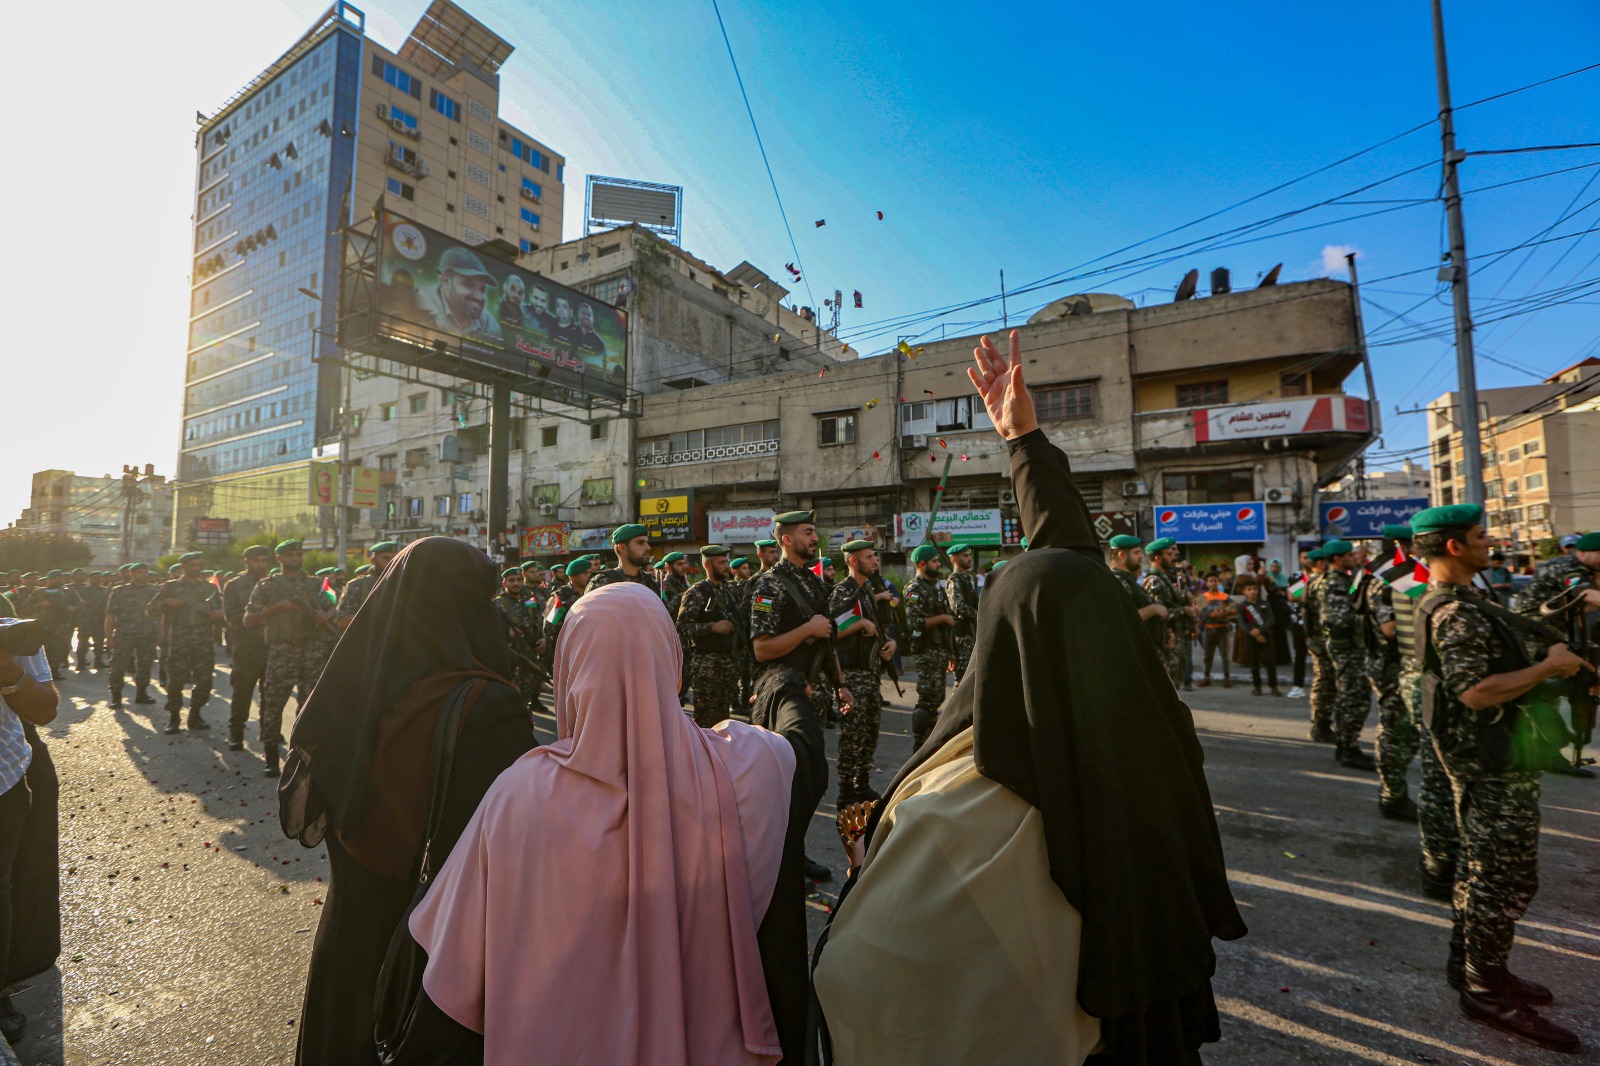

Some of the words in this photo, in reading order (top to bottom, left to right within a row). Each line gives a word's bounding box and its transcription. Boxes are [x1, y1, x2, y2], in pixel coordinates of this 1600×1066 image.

[556, 350, 585, 373] رجال
[1228, 412, 1254, 425] الشام
[1256, 410, 1291, 422] ياسمين
[1182, 509, 1209, 519] ماركت
[1210, 509, 1232, 520] ميني
[1357, 506, 1392, 517] ماركت
[1394, 505, 1421, 517] ميني
[661, 515, 688, 526] البرعصي
[926, 514, 958, 524] البرعص
[958, 511, 992, 525] خدماتي
[1191, 521, 1223, 532] السرايا
